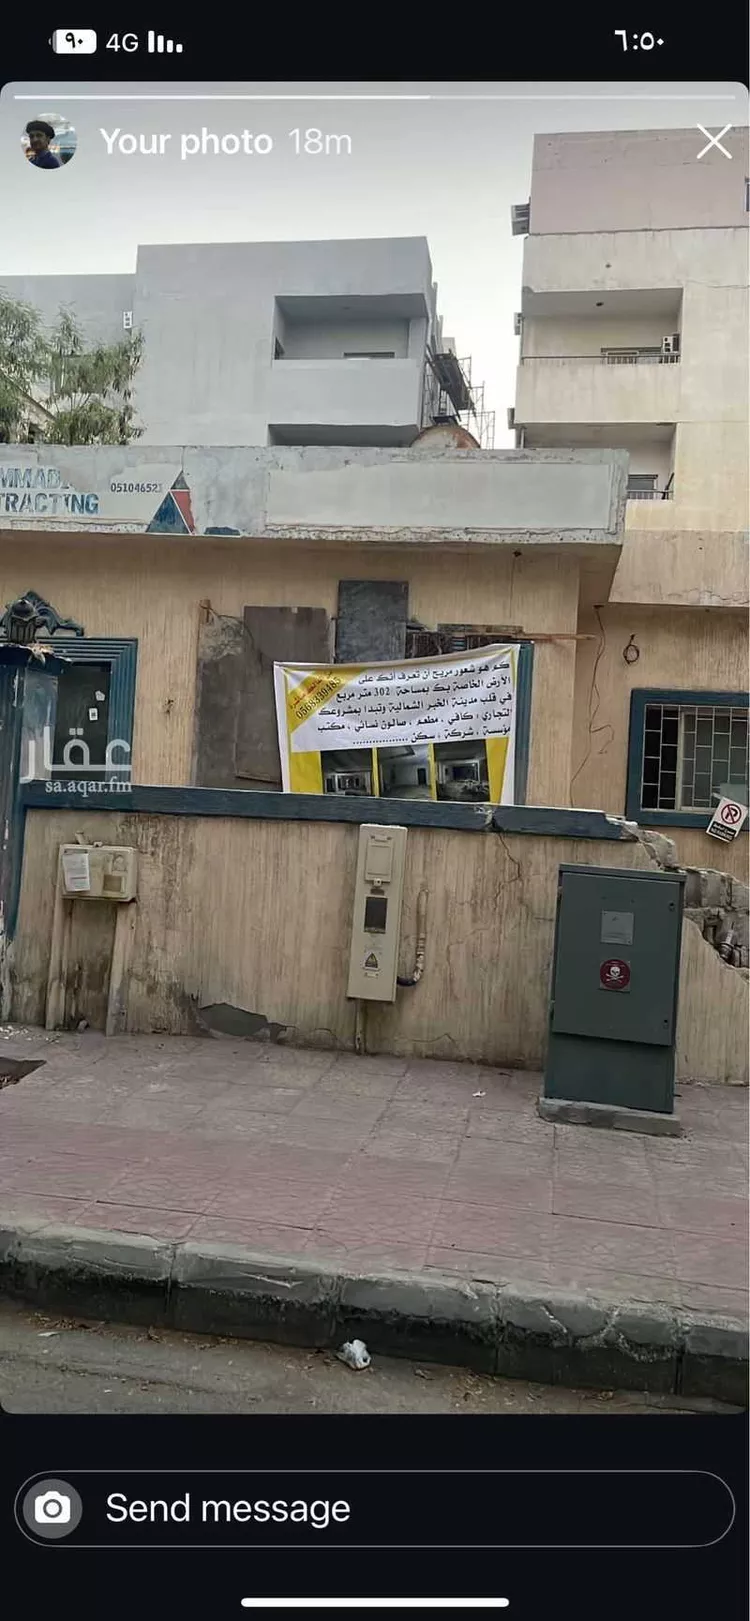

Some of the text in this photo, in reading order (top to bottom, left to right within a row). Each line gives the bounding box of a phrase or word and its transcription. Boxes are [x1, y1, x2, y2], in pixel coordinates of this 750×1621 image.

[0, 467, 70, 489] MMAD
[432, 669, 453, 679] مريح
[454, 664, 476, 677] شعور
[477, 664, 490, 675] هو
[397, 670, 420, 682] تعرف
[396, 684, 430, 697] بمساحة
[432, 683, 451, 693] بك
[452, 679, 484, 691] الخاصة
[295, 676, 342, 719] 0568339485
[335, 692, 355, 703] مربع
[358, 688, 372, 700] متر
[374, 686, 390, 697] 302
[426, 698, 449, 710] الخبر
[451, 696, 478, 707] مدينة
[480, 692, 497, 705] قلب
[499, 692, 512, 705] في
[318, 704, 362, 718] بمشروعك
[388, 699, 424, 713] الشمالية
[381, 718, 407, 730] صالون
[416, 715, 439, 725] مطعم
[447, 711, 474, 725] كافي
[317, 721, 345, 732] مكتب
[354, 719, 378, 732] نسائي
[444, 725, 474, 738] شركة
[483, 723, 511, 735] مؤسسة
[410, 730, 436, 743] سكن
